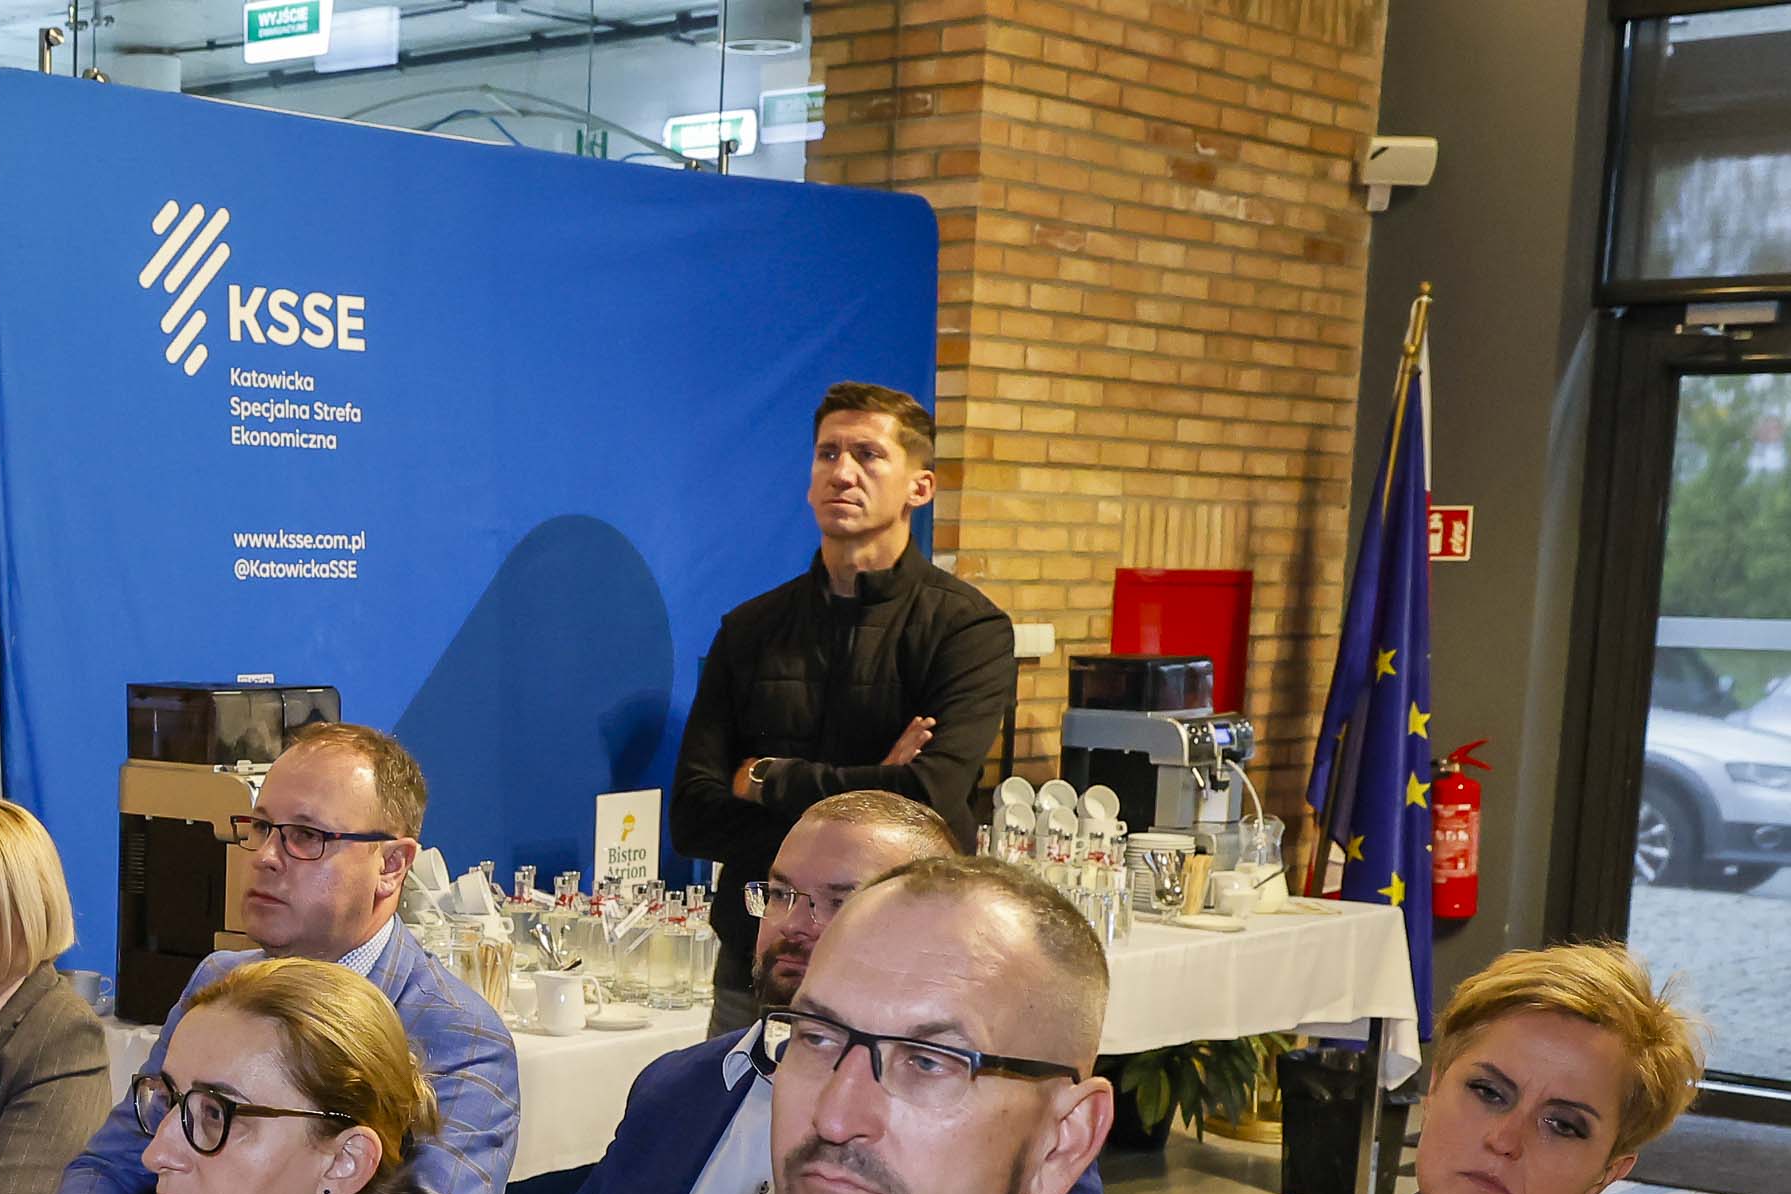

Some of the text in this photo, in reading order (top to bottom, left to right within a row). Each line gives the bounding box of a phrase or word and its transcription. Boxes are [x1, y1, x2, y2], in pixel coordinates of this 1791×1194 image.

[258, 7, 308, 27] WYJŚCIE
[228, 284, 366, 352] KSSE
[230, 367, 315, 391] Katowicka
[230, 396, 362, 423] Specjalna Strefa
[231, 425, 337, 450] Ekonomiczna
[233, 528, 366, 554] www.ksse.com.pl
[234, 558, 358, 580] @KatowickaSSE
[608, 846, 647, 864] Bistro
[608, 862, 647, 879] Atrion
